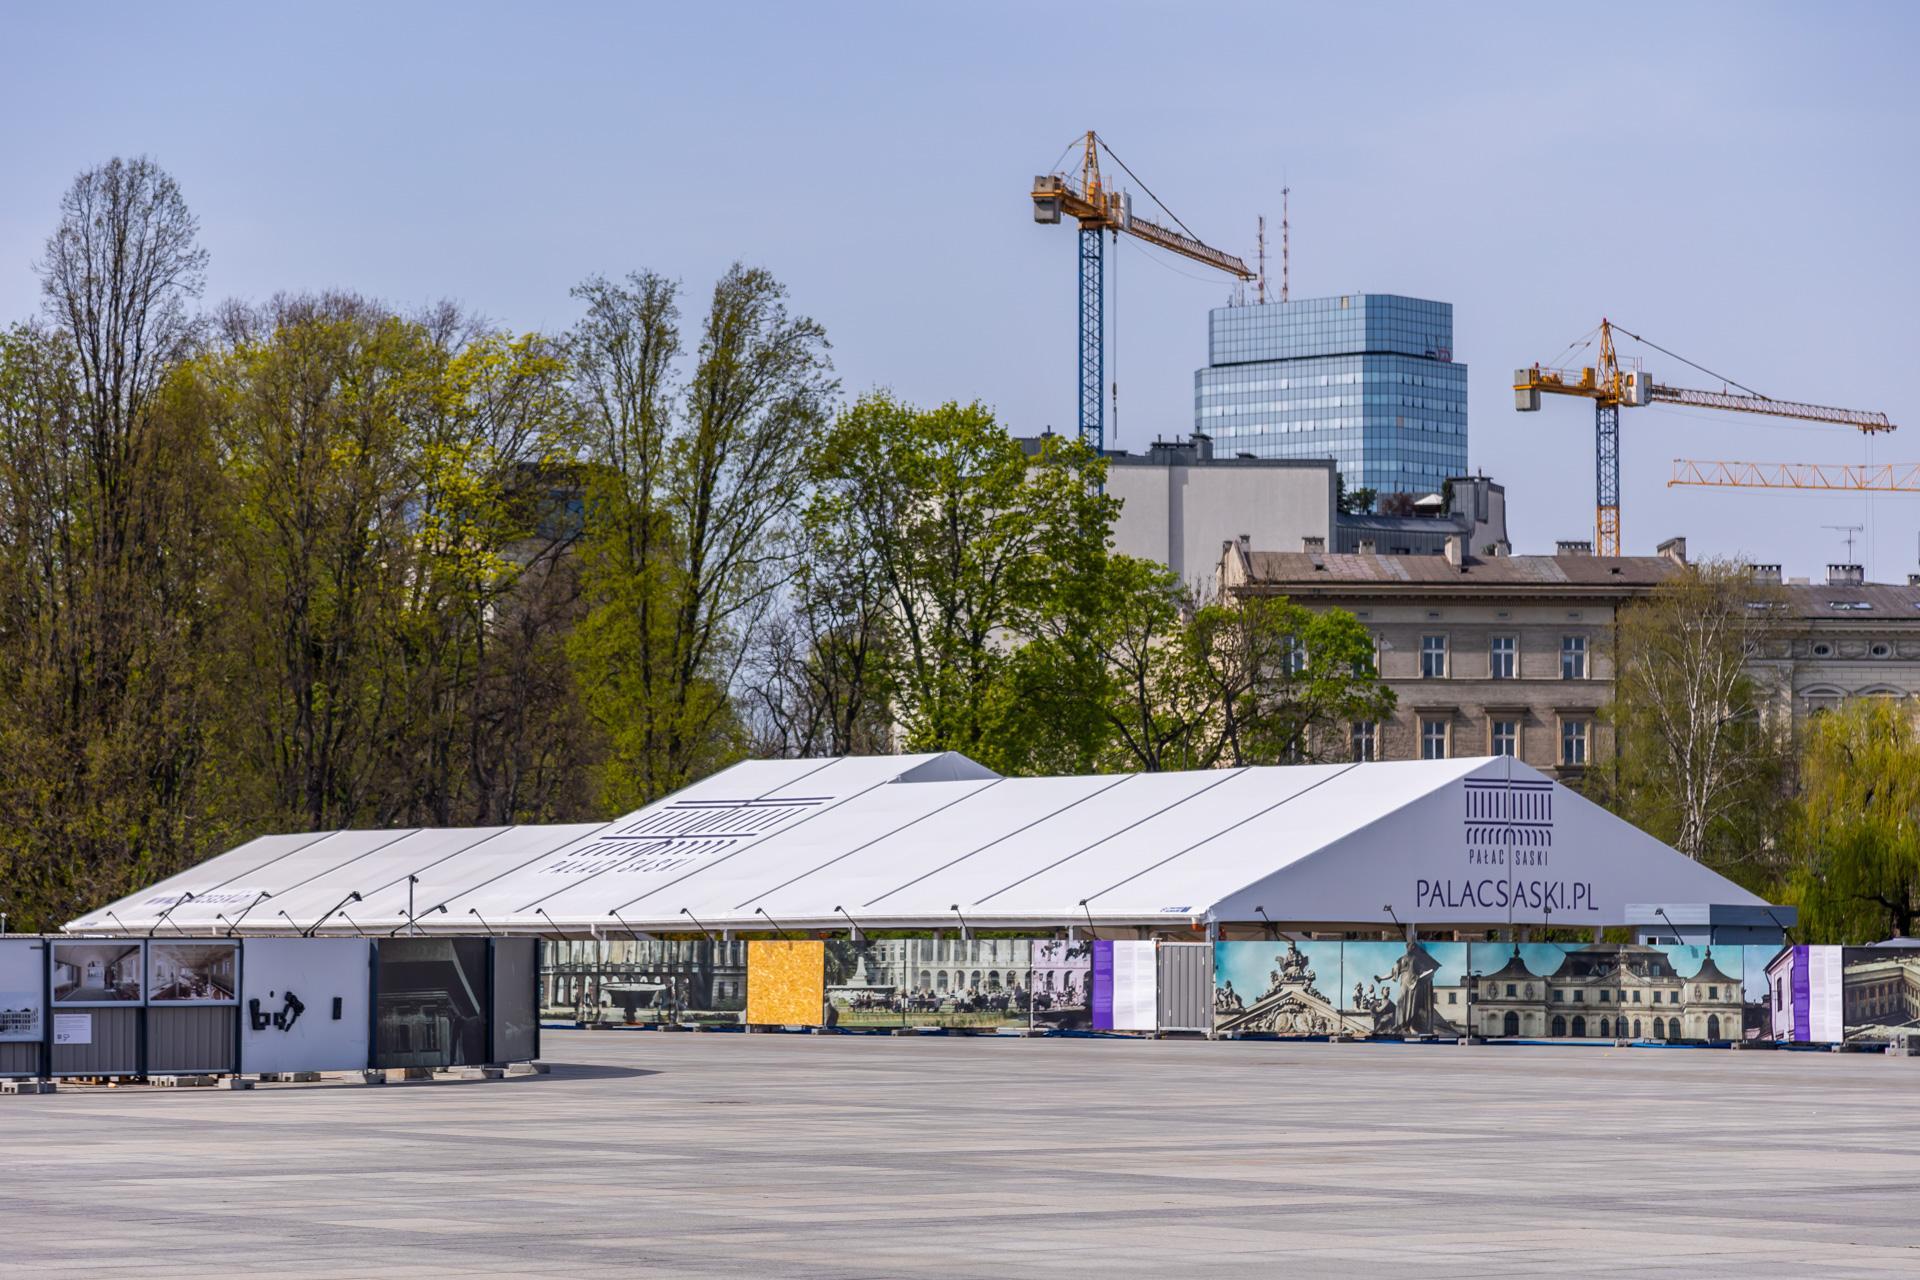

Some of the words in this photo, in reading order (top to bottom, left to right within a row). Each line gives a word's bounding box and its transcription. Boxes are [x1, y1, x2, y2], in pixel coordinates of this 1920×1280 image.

[1469, 848, 1504, 865] PAŁAC
[1514, 849, 1548, 866] SASKI
[1416, 879, 1599, 911] PALACSASKI.PL
